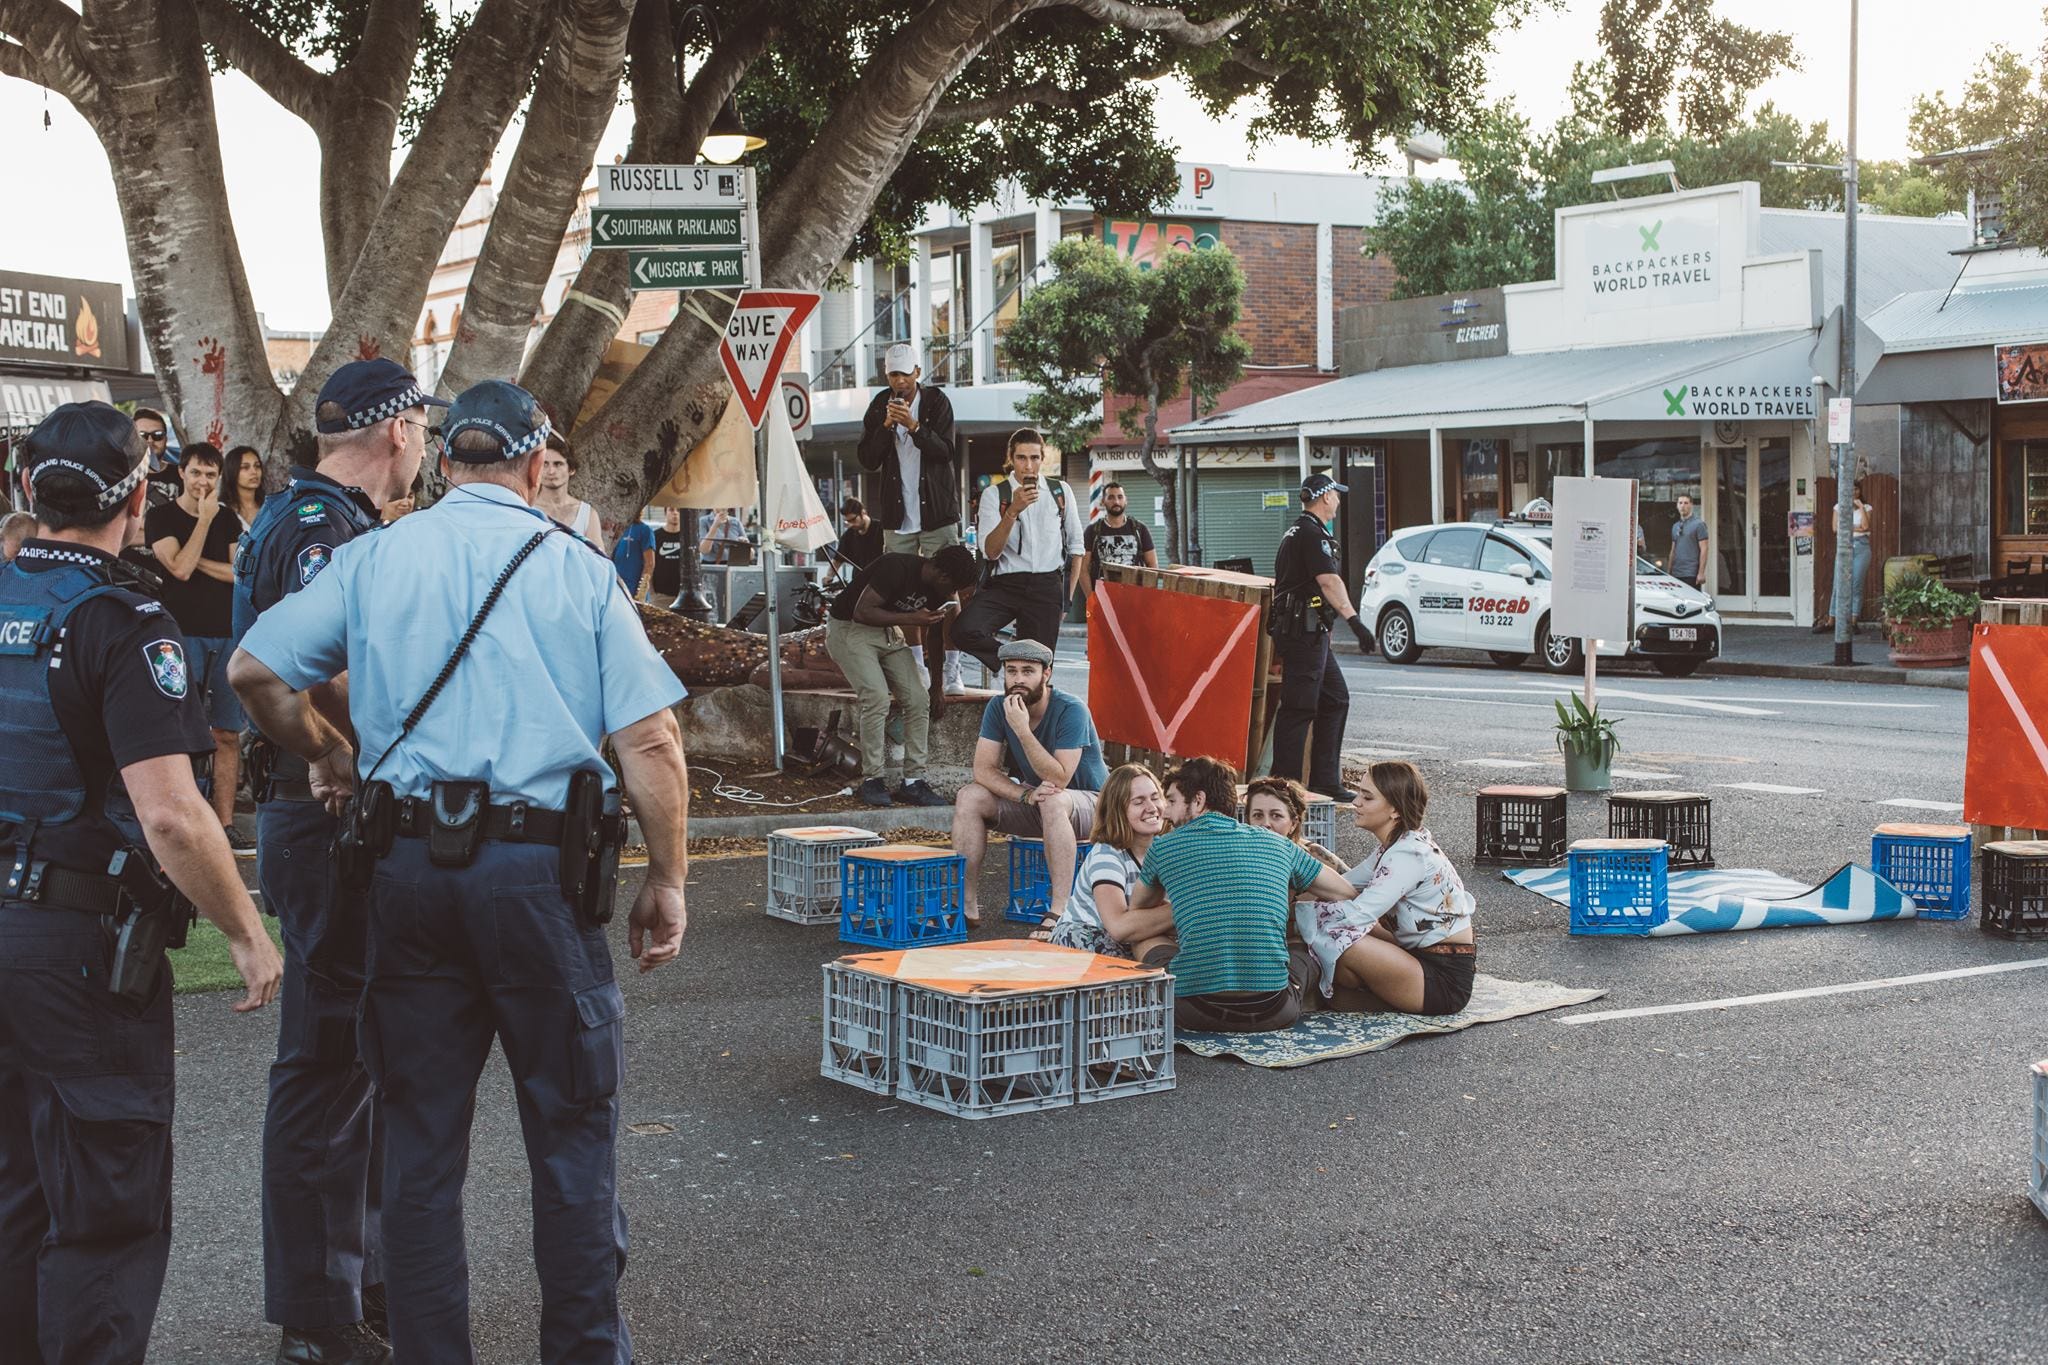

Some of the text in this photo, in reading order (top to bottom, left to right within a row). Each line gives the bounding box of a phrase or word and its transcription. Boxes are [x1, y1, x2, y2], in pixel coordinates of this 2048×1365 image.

[610, 169, 683, 191] RUSSELL
[611, 219, 737, 236] SOUTHBANK PARKLANDS
[712, 261, 739, 276] PARK
[1592, 251, 1712, 276] BACKPACKERS
[1594, 268, 1711, 293] WORLD TRAVEL
[0, 287, 66, 319] ST END
[1452, 298, 1467, 315] THE
[0, 318, 69, 352] ARCOAL
[728, 315, 776, 338] GIVE
[1456, 323, 1500, 344] BLEACHERS
[736, 343, 769, 361] WAY
[1691, 386, 1812, 398] BACKPACKERS
[789, 395, 804, 419] 0
[1692, 402, 1813, 416] WORLD TRAVEL
[471, 417, 493, 426] POLICE
[494, 423, 514, 444] SERVICE
[1097, 450, 1125, 461] MURRI
[1127, 449, 1170, 460] COTRY
[60, 458, 84, 472] POLICE
[84, 468, 108, 490] SERVICE
[30, 548, 48, 559] QPS
[1468, 596, 1530, 614] 13ecab
[1480, 615, 1513, 626] 133 222
